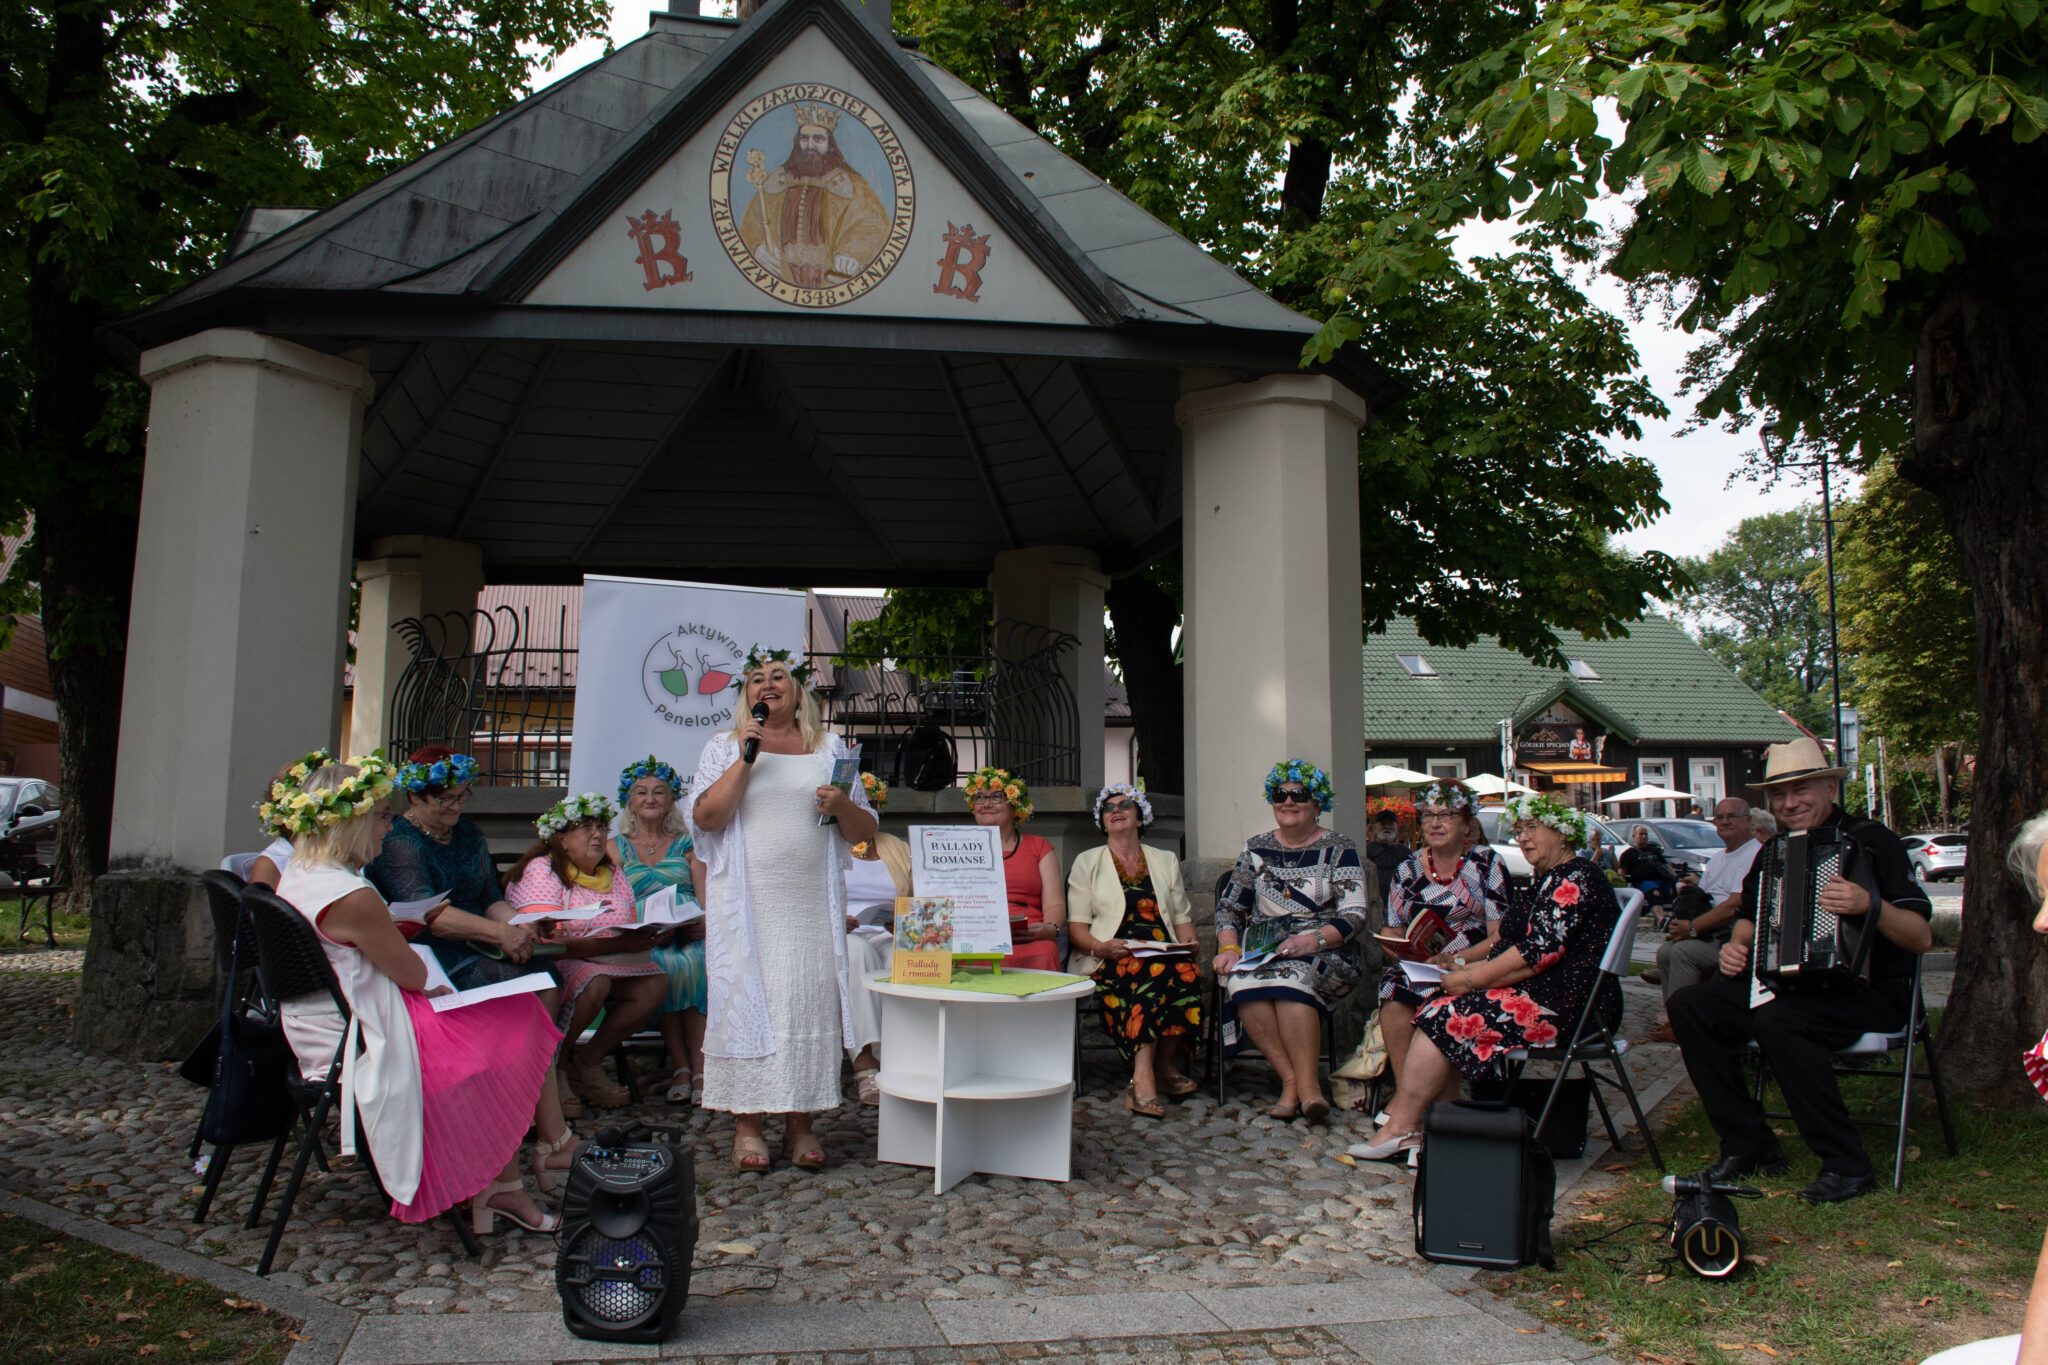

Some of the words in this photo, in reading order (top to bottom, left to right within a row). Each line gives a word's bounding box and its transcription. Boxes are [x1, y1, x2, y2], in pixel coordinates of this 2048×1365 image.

[713, 110, 754, 174] WIELKI
[871, 123, 911, 186] MIASTA
[713, 198, 779, 293] KAZIMIERZ
[846, 195, 912, 298] PIWNICZNEJ
[792, 289, 837, 305] 1348
[677, 622, 744, 659] Aktywne
[654, 703, 732, 727] Penelopy
[931, 842, 984, 851] BALLADY
[932, 855, 986, 864] ROMANSE
[907, 959, 938, 972] Ballady
